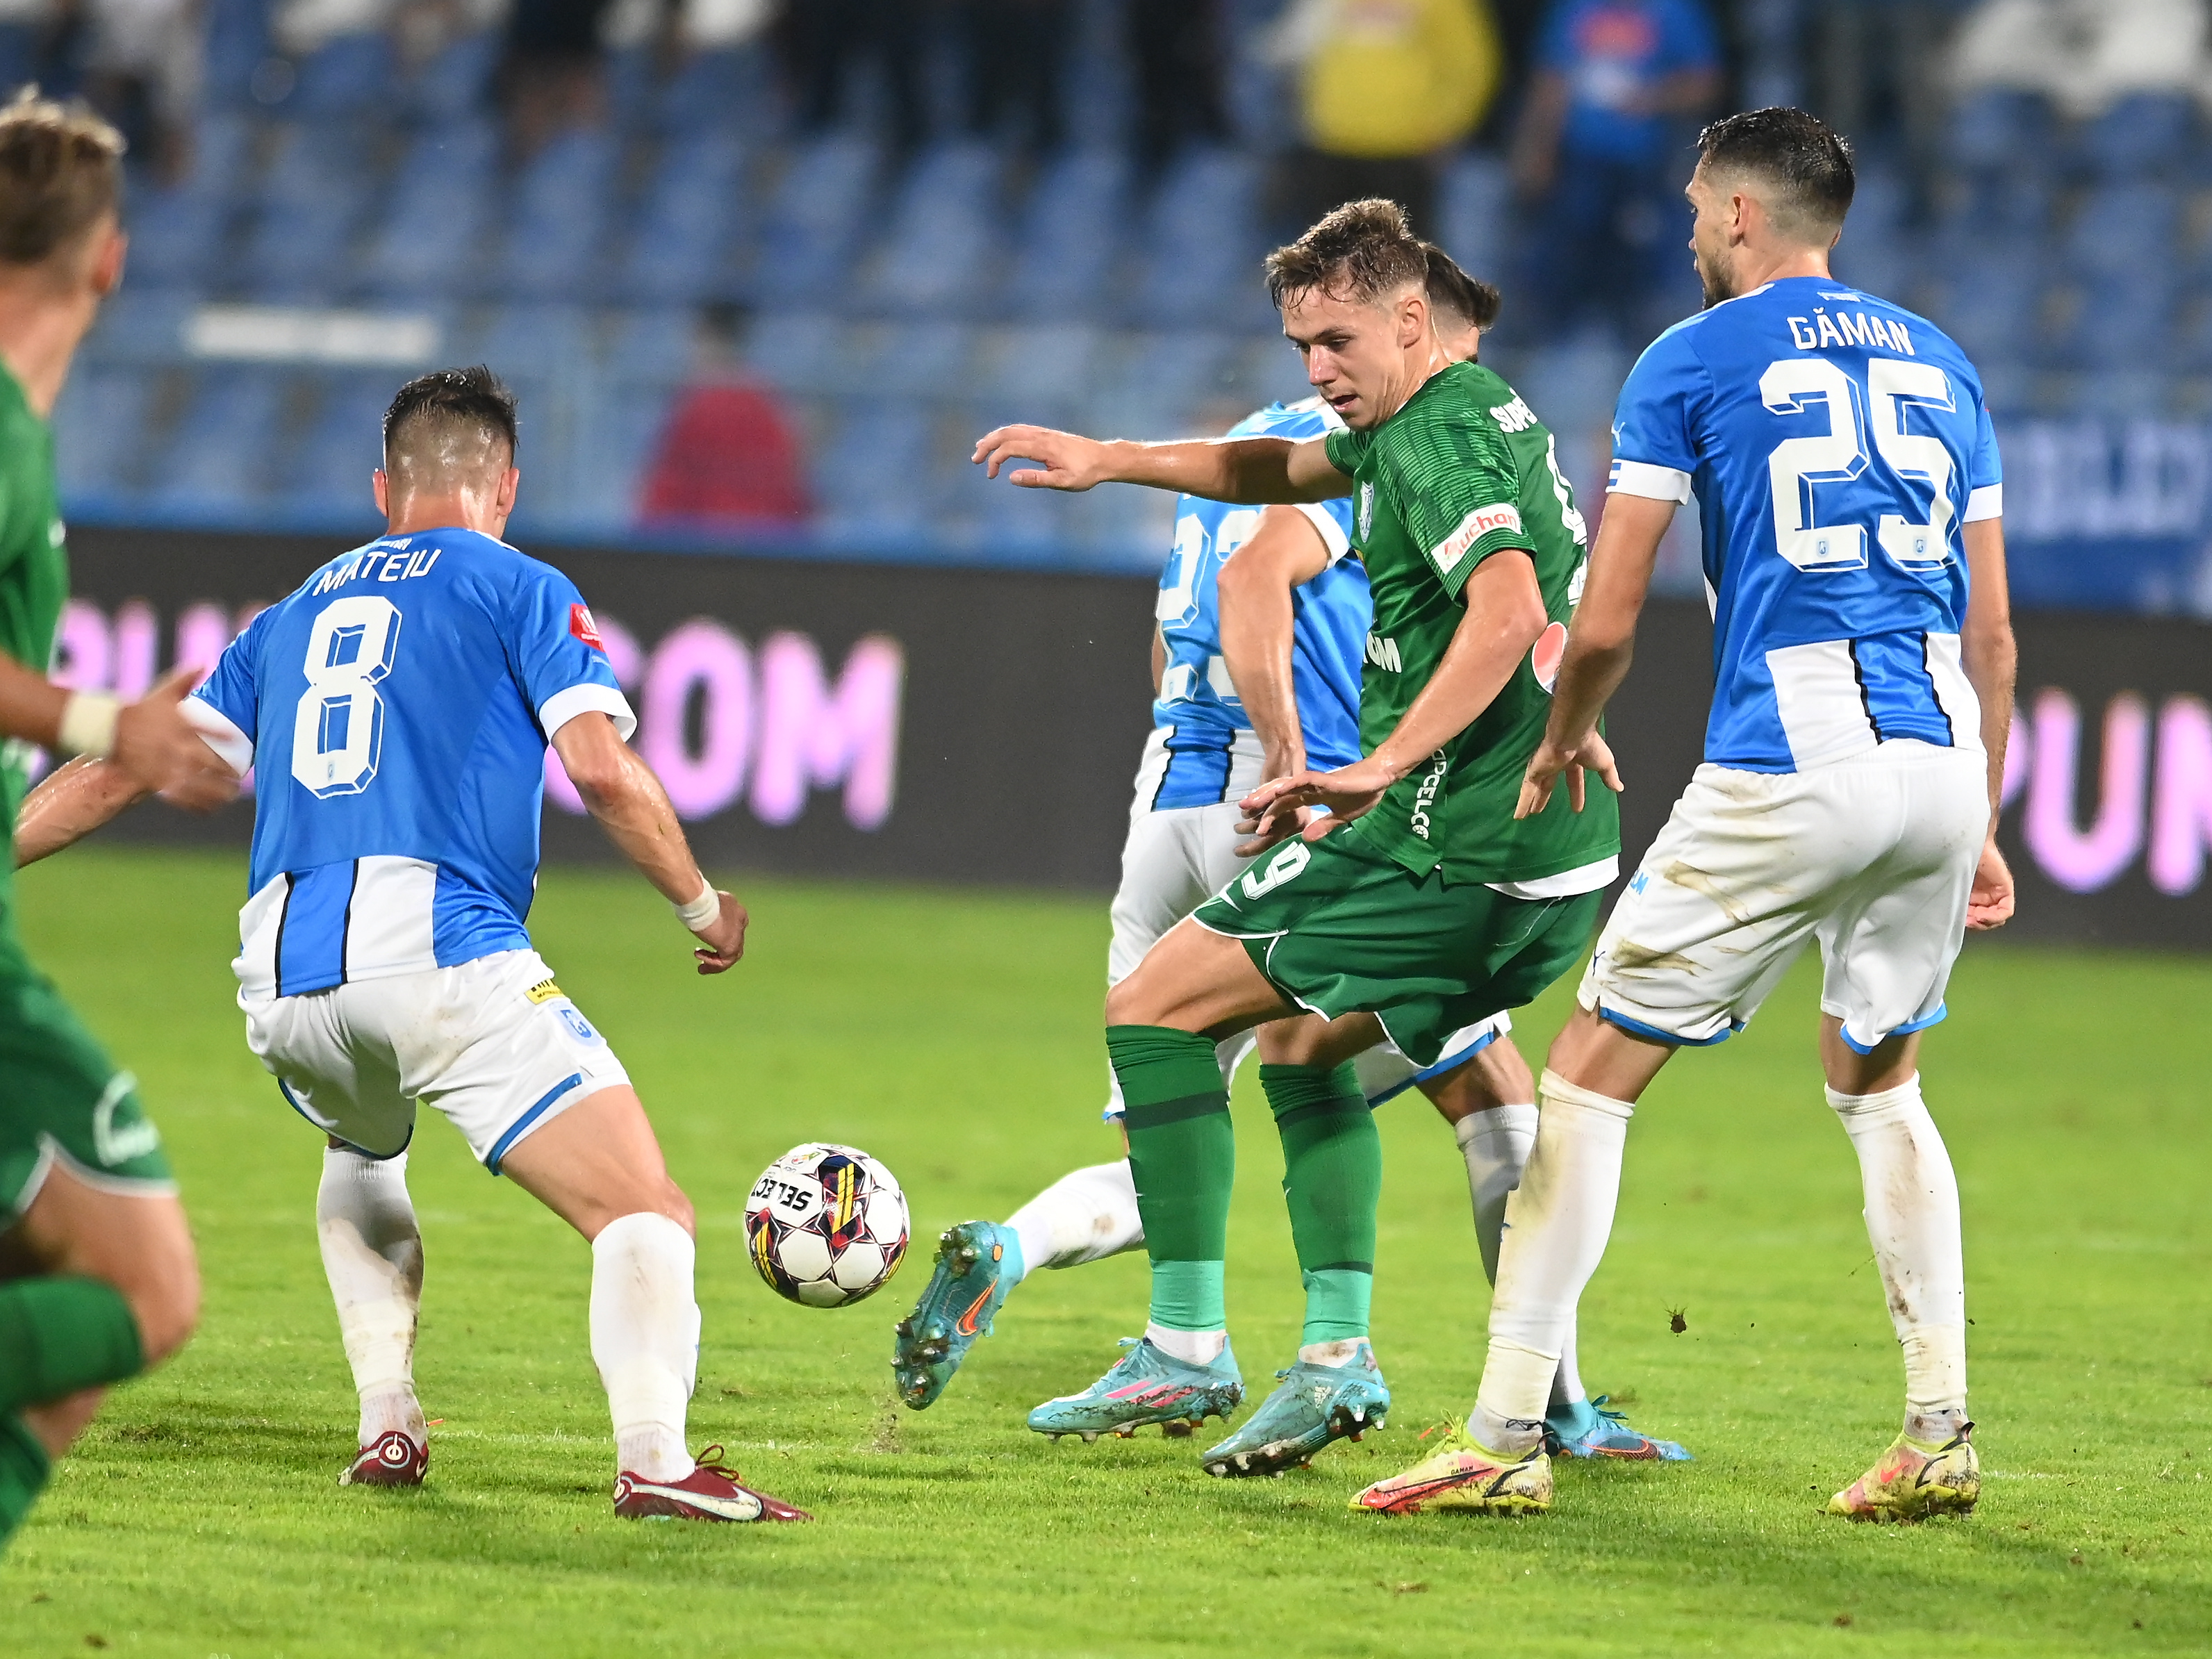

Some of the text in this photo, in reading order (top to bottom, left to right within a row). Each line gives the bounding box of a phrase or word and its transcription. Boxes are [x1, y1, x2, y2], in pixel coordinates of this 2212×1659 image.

[1786, 306, 1915, 356] GĂMAN
[1758, 358, 1958, 574] 25
[312, 548, 442, 597] MATEIU
[291, 595, 402, 800] 8
[1241, 841, 1312, 901] 9
